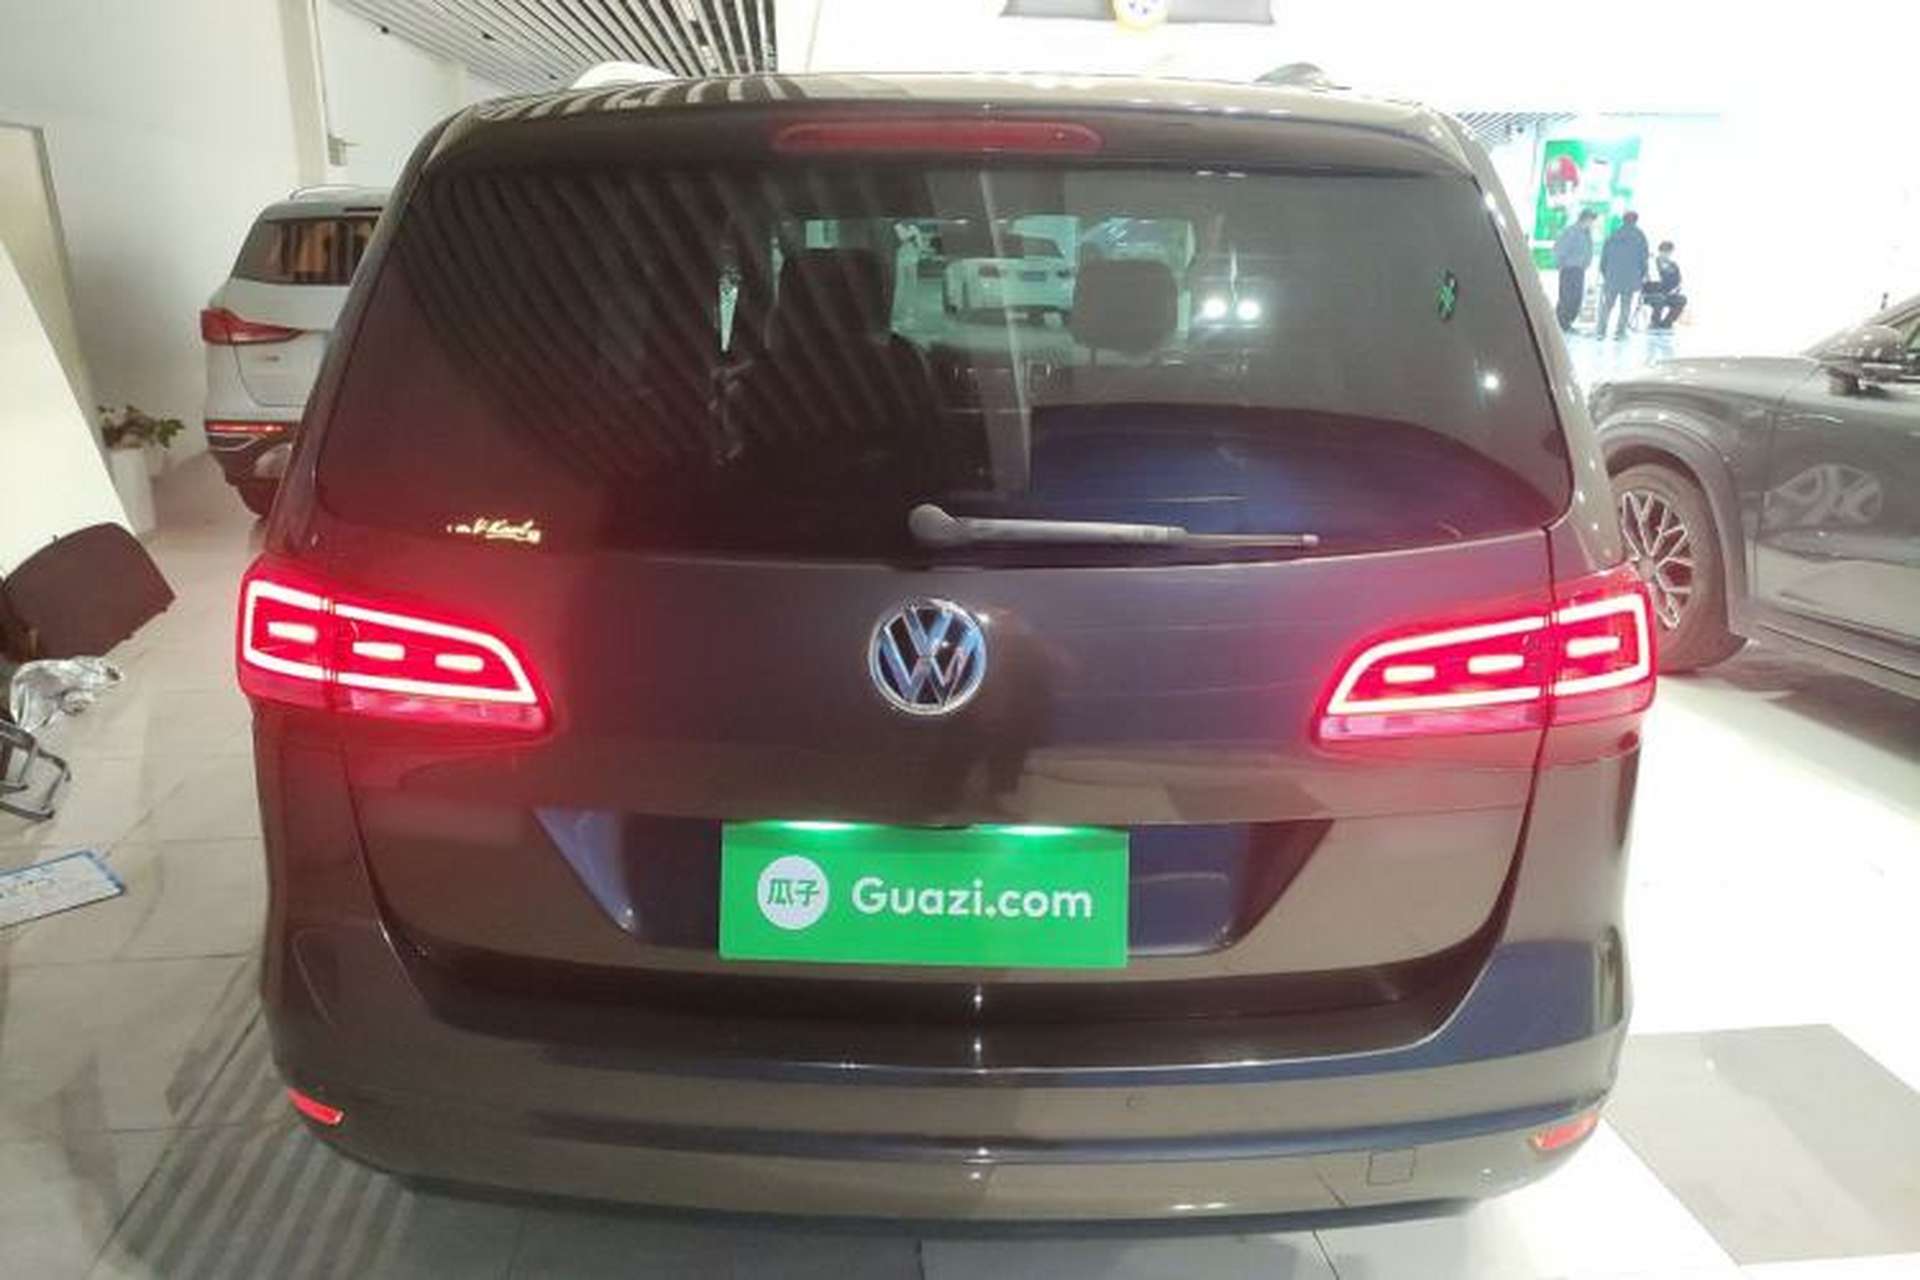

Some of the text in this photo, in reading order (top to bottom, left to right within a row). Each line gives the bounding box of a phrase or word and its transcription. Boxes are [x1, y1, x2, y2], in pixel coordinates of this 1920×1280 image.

[872, 600, 985, 712] VW
[766, 878, 821, 908] 瓜子
[851, 876, 1093, 919] Guazi.com
